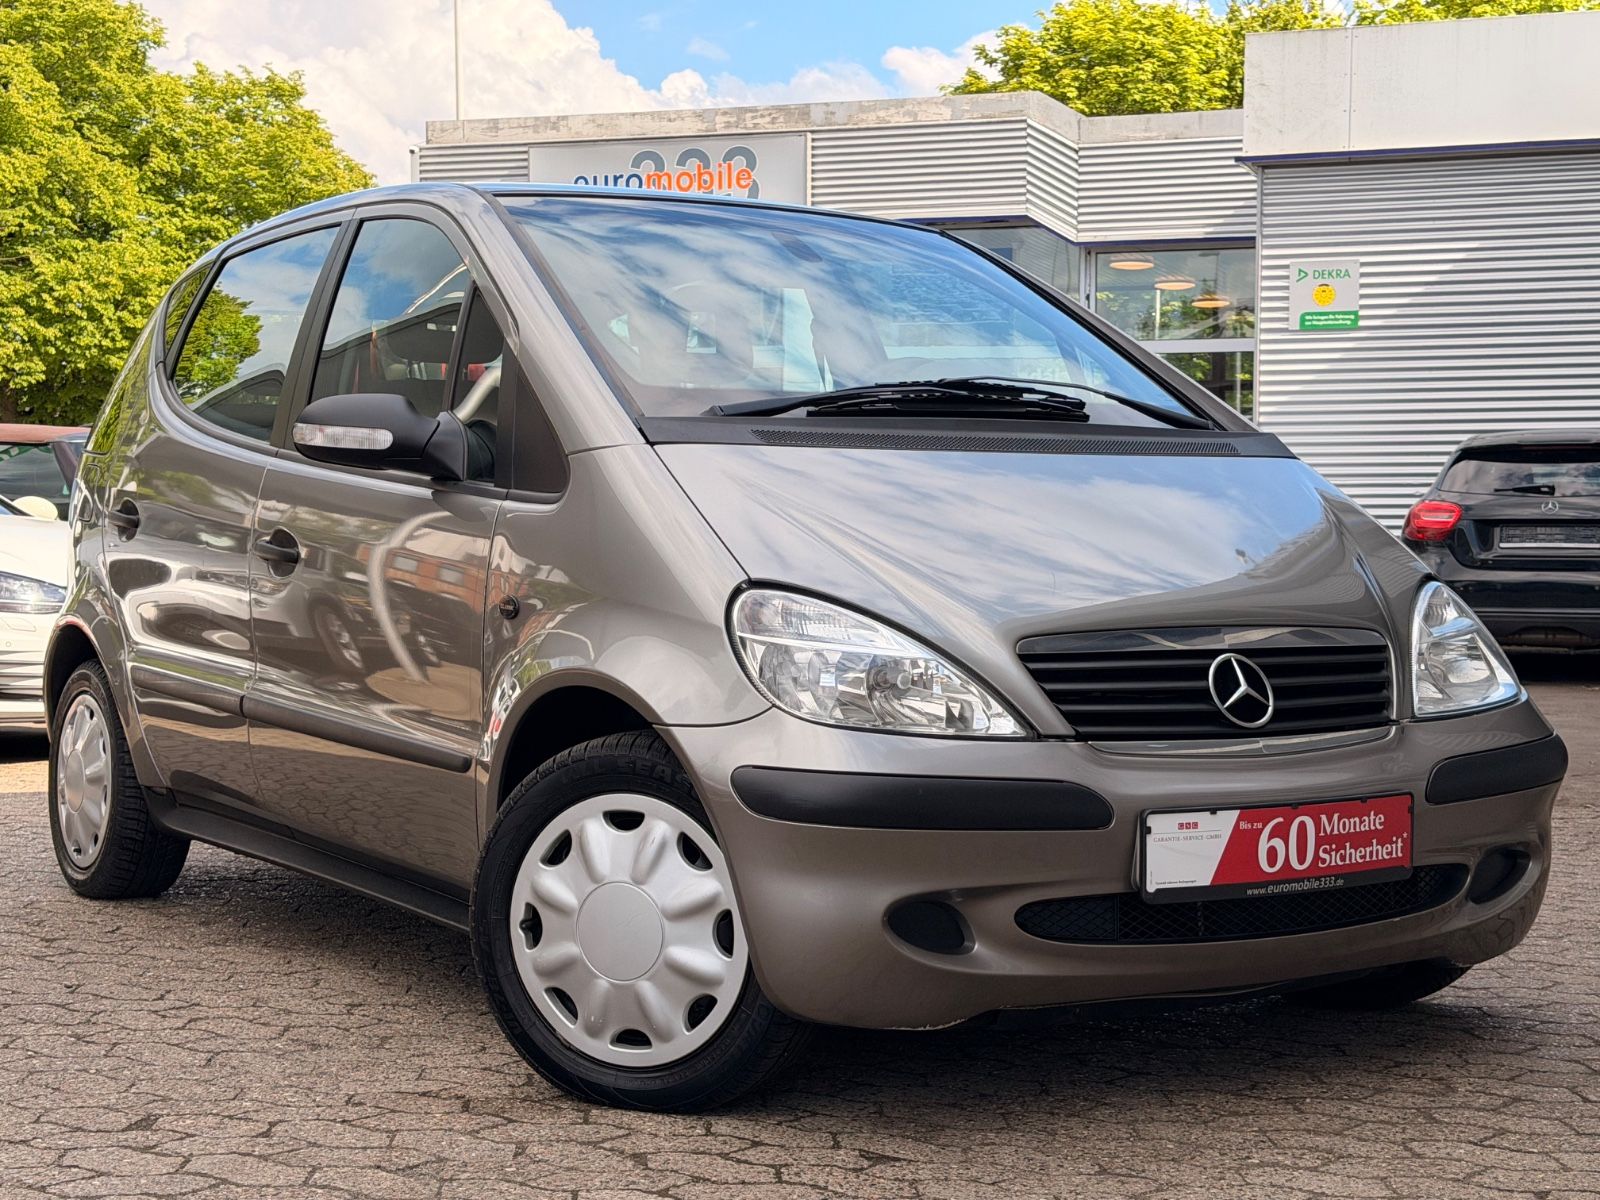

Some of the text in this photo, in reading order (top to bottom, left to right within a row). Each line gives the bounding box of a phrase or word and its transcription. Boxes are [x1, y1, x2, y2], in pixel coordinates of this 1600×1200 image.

[1312, 269, 1351, 280] DEKRA
[1239, 821, 1263, 830] Bis zu
[1319, 810, 1384, 836] Monate
[1258, 815, 1316, 873] 60
[1246, 877, 1345, 896] www.euromobile333.de
